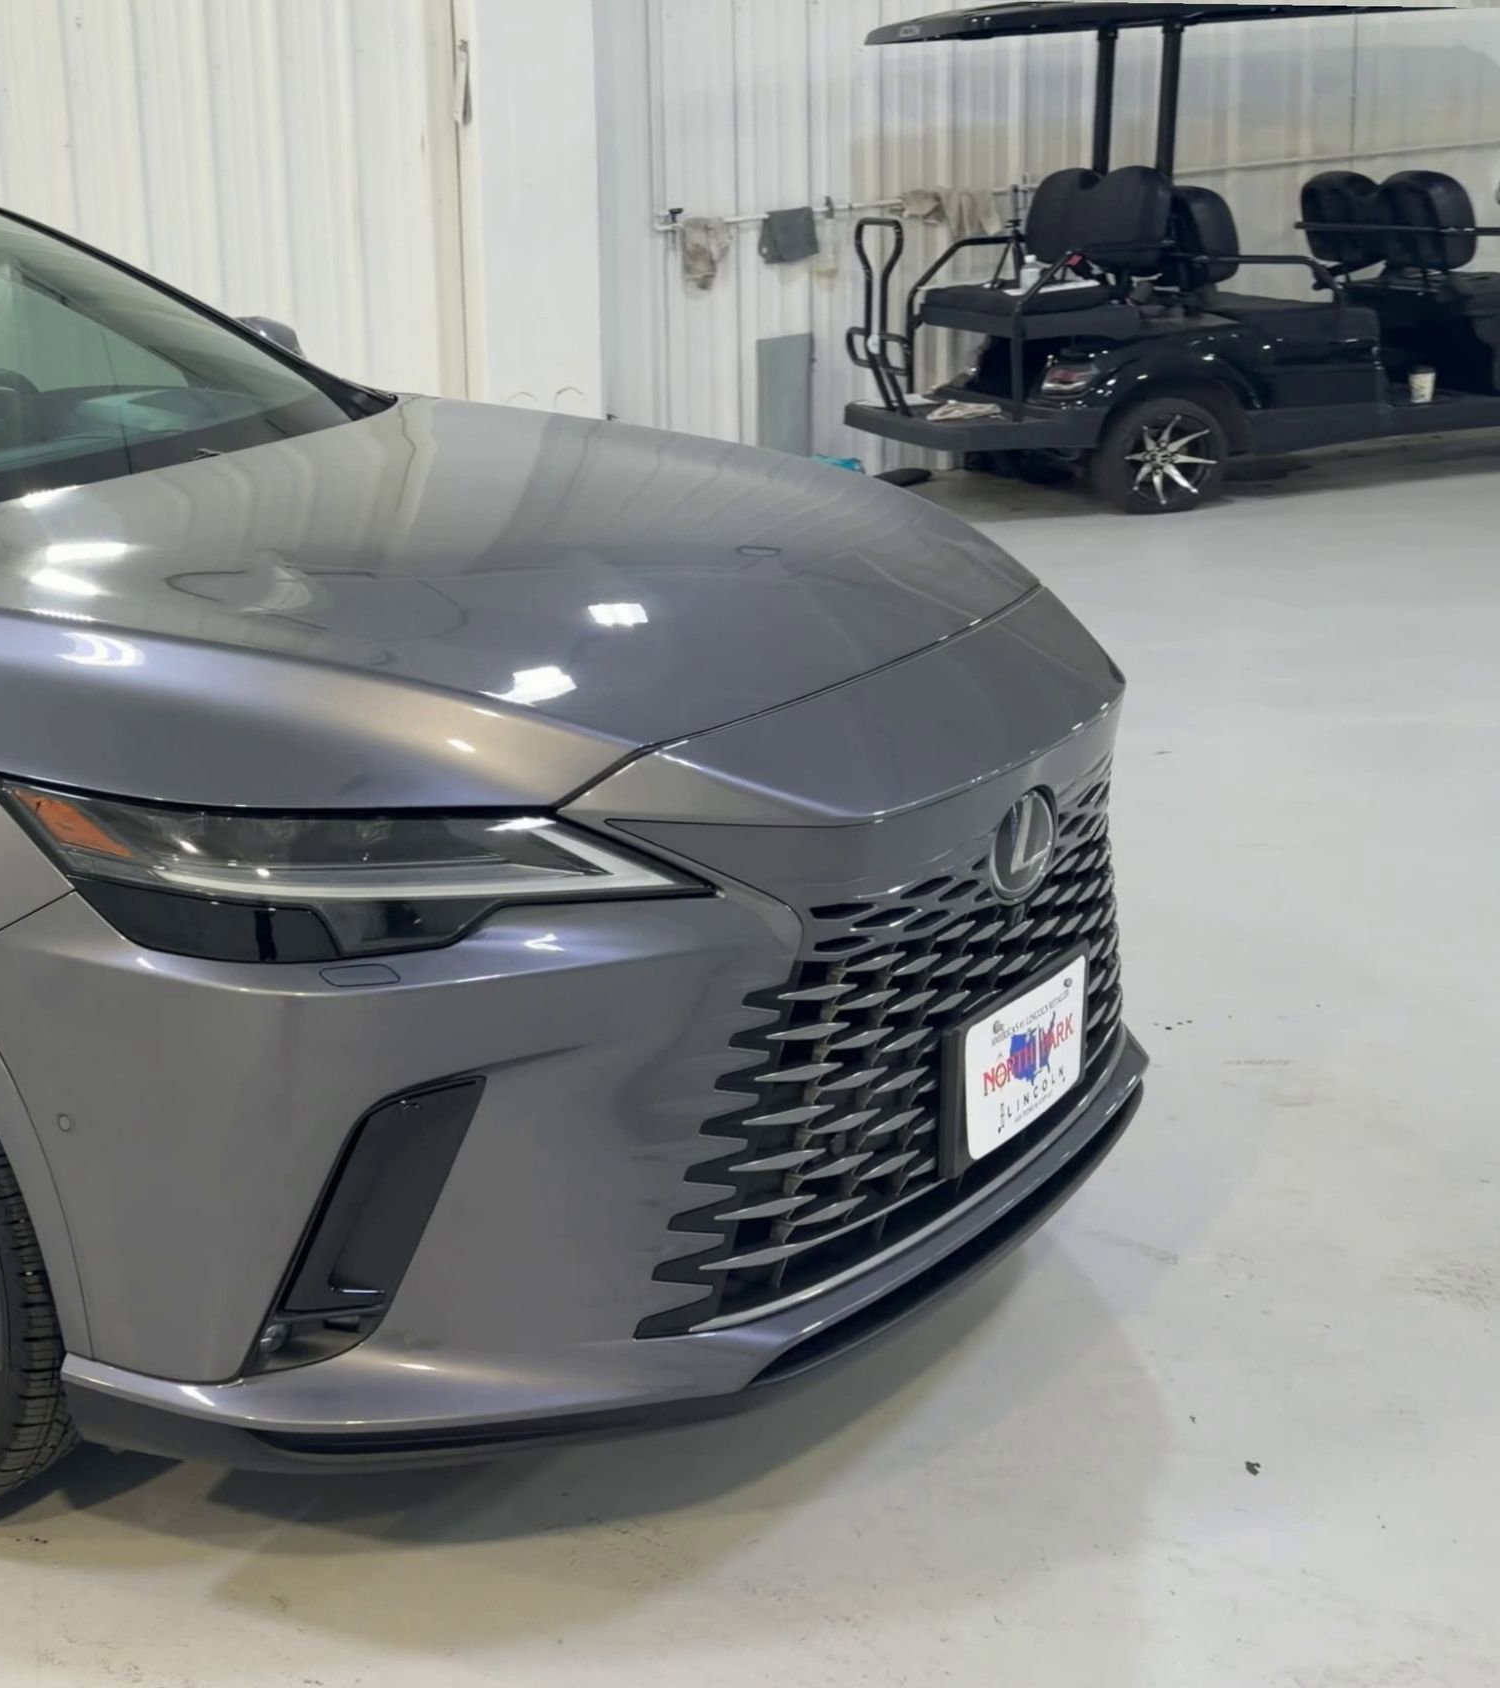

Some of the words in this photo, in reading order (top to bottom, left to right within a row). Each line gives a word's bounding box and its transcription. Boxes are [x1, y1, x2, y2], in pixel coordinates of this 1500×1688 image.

[982, 1037, 1036, 1096] NORTH
[1039, 1012, 1074, 1062] PARK
[1007, 1065, 1064, 1118] LINCOLN
